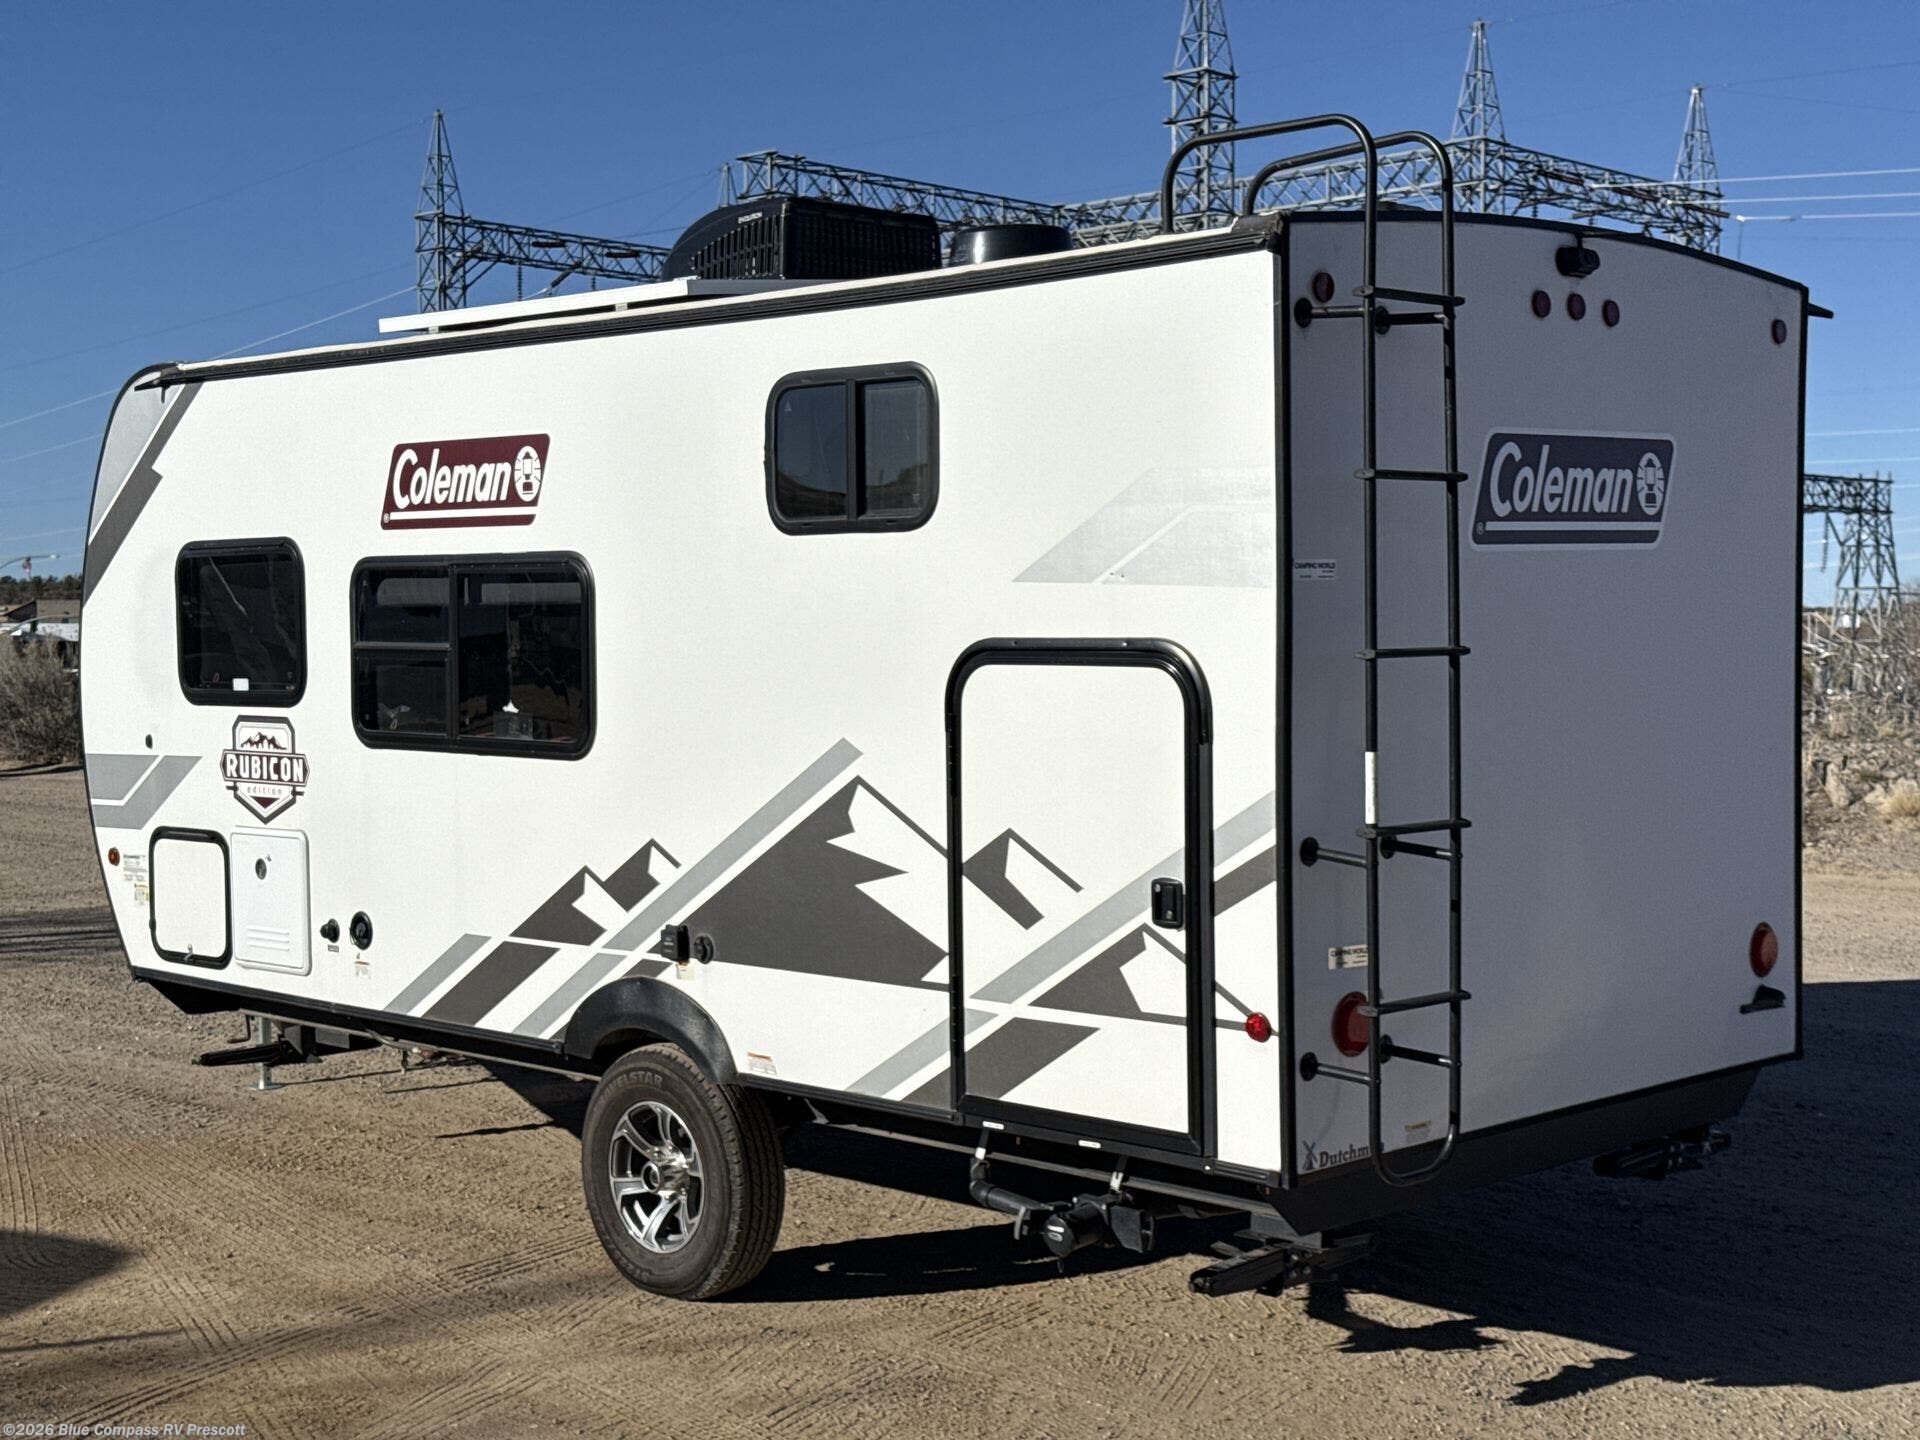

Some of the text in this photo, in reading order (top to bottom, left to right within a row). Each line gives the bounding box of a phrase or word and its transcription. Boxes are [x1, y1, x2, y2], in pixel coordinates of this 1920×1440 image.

[392, 447, 512, 510] Coleman
[1489, 441, 1634, 518] Coleman
[226, 753, 304, 782] RUBICON
[247, 786, 283, 796] edition
[1319, 1141, 1385, 1168] Dutchm
